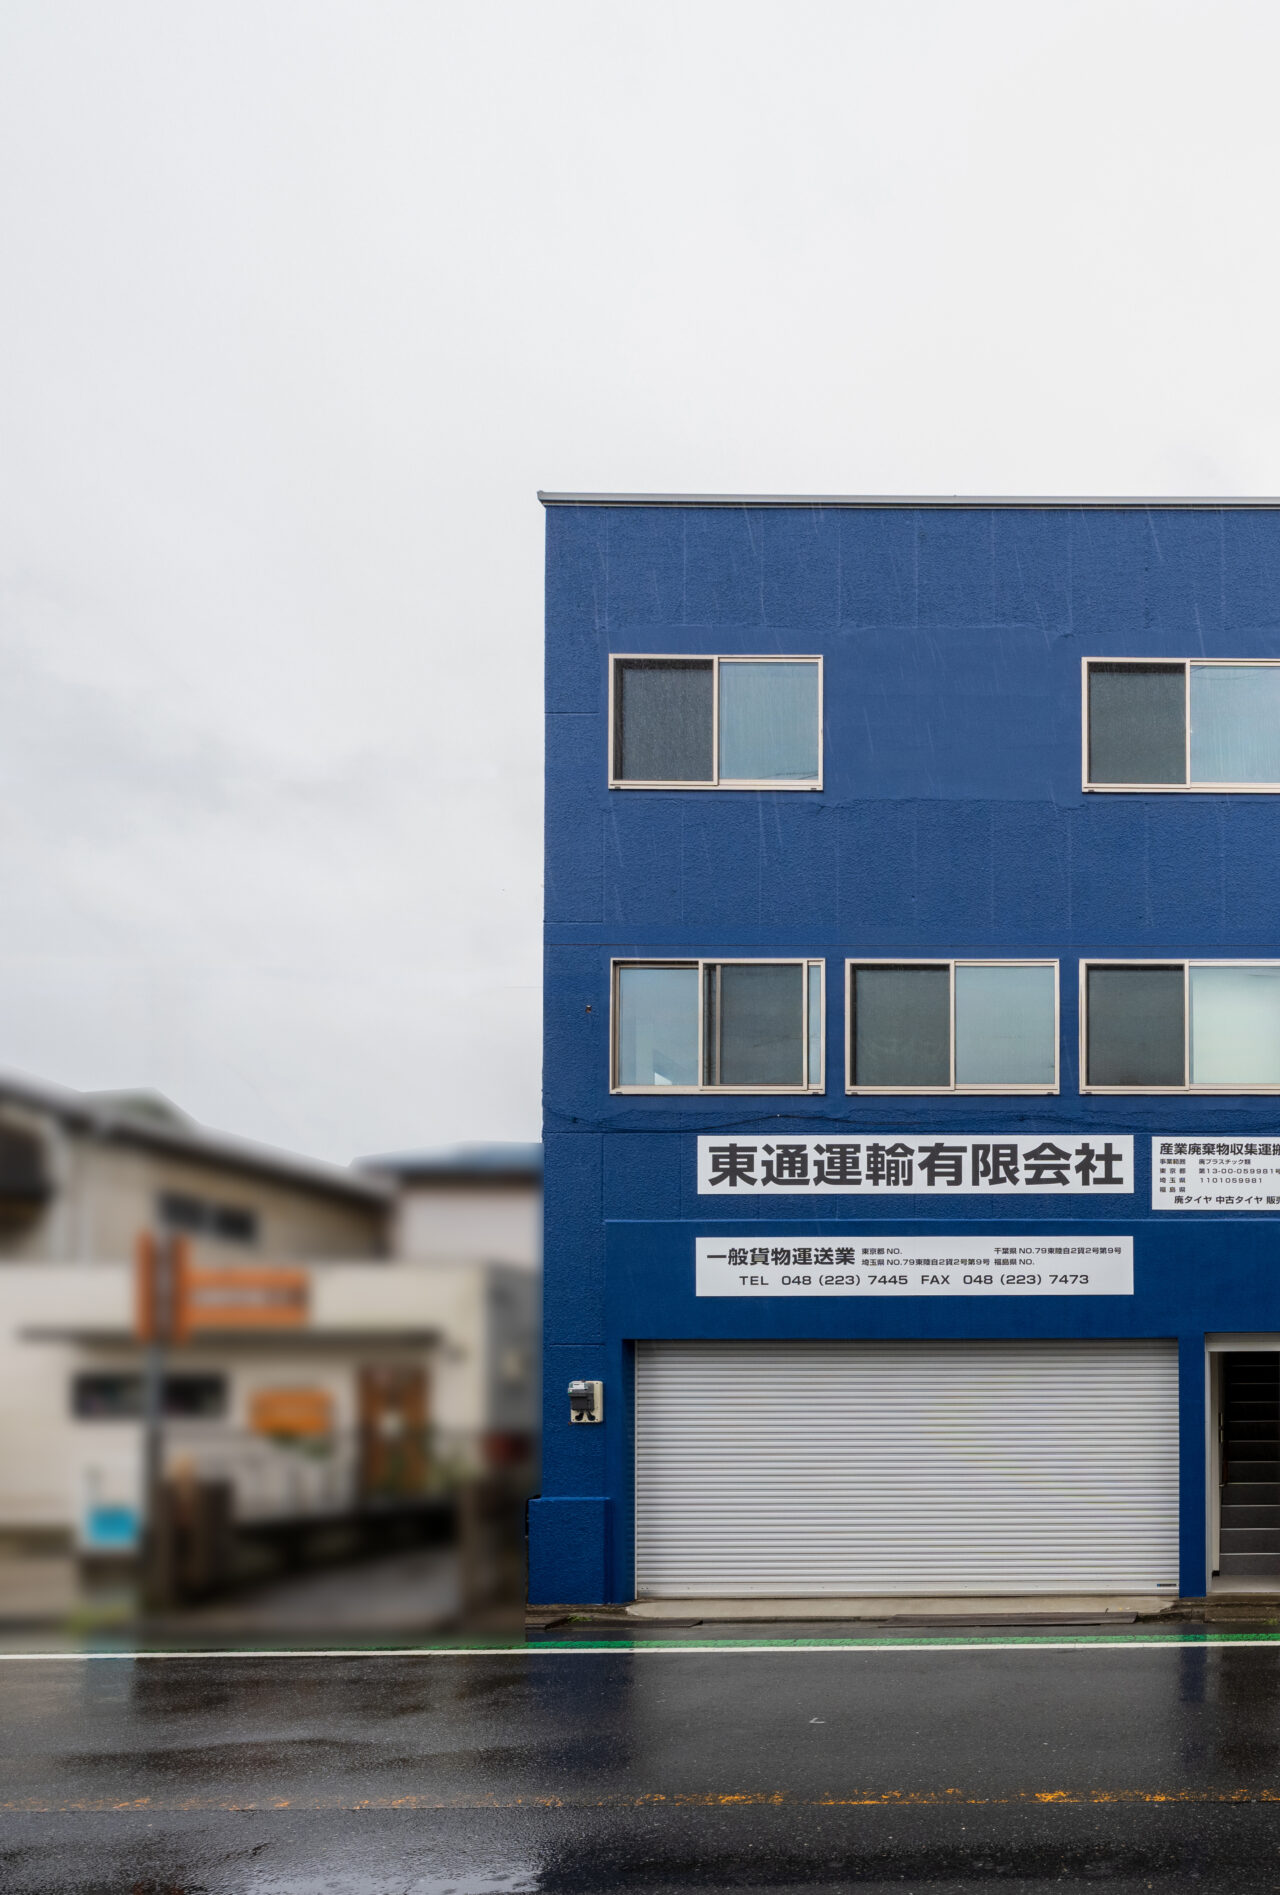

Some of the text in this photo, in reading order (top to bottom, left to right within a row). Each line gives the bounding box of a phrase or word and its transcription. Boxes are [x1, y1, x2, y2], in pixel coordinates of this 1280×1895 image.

[708, 1142, 1123, 1187] 東通運輸有限会社
[1174, 1195, 1212, 1204] 廃タイヤ
[1216, 1196, 1263, 1204] 中古タイヤ
[707, 1247, 855, 1266] 一般貨物運送業
[739, 1274, 1089, 1286] TEL 048 (223) 7445 FAX 048 (223) 7473
